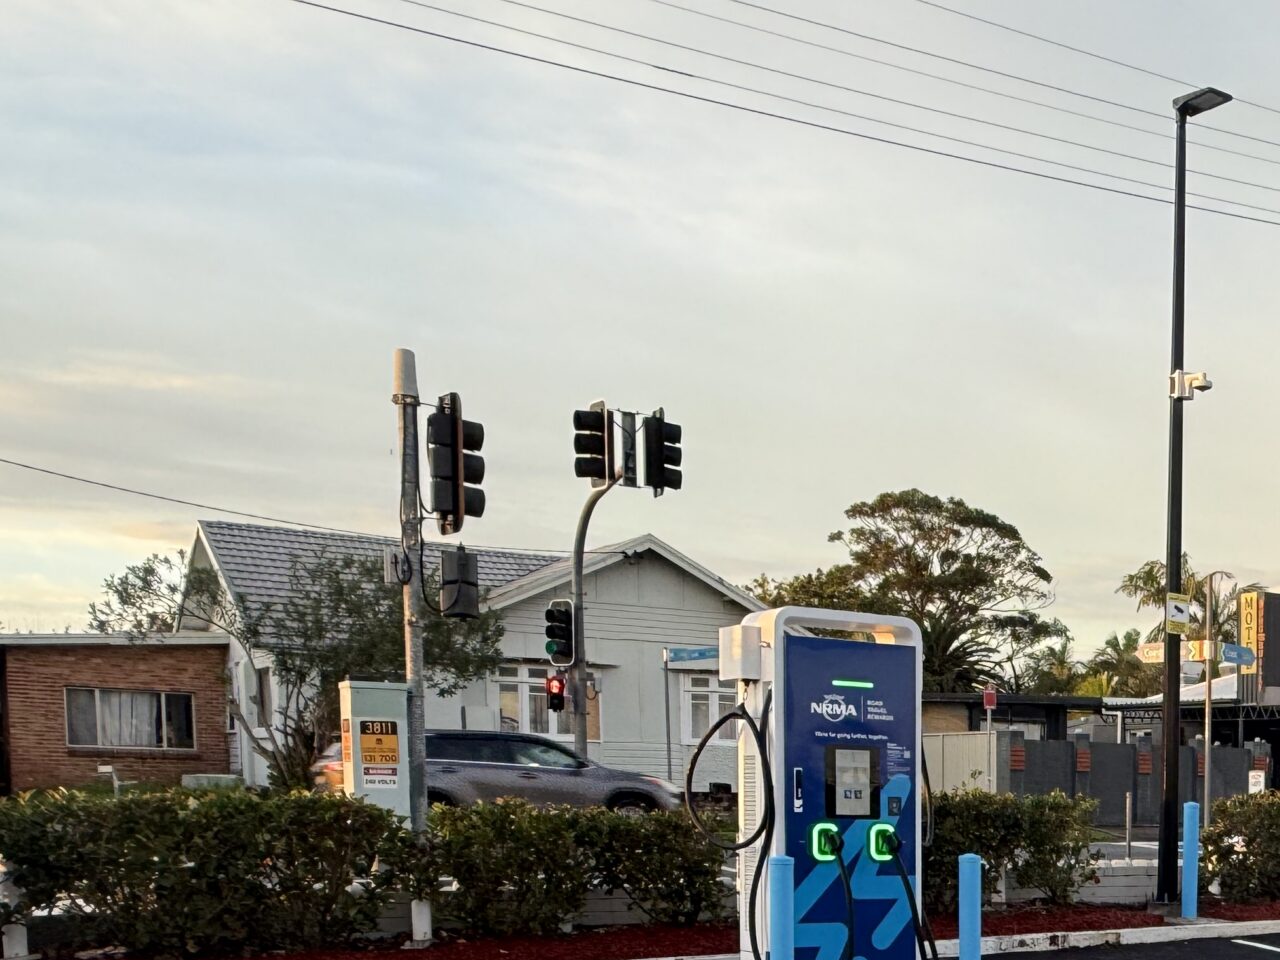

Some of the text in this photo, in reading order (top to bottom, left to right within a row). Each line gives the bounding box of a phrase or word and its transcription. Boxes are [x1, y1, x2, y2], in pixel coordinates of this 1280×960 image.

[810, 702, 858, 716] NRMA
[365, 722, 392, 734] 3811
[379, 754, 397, 762] 700
